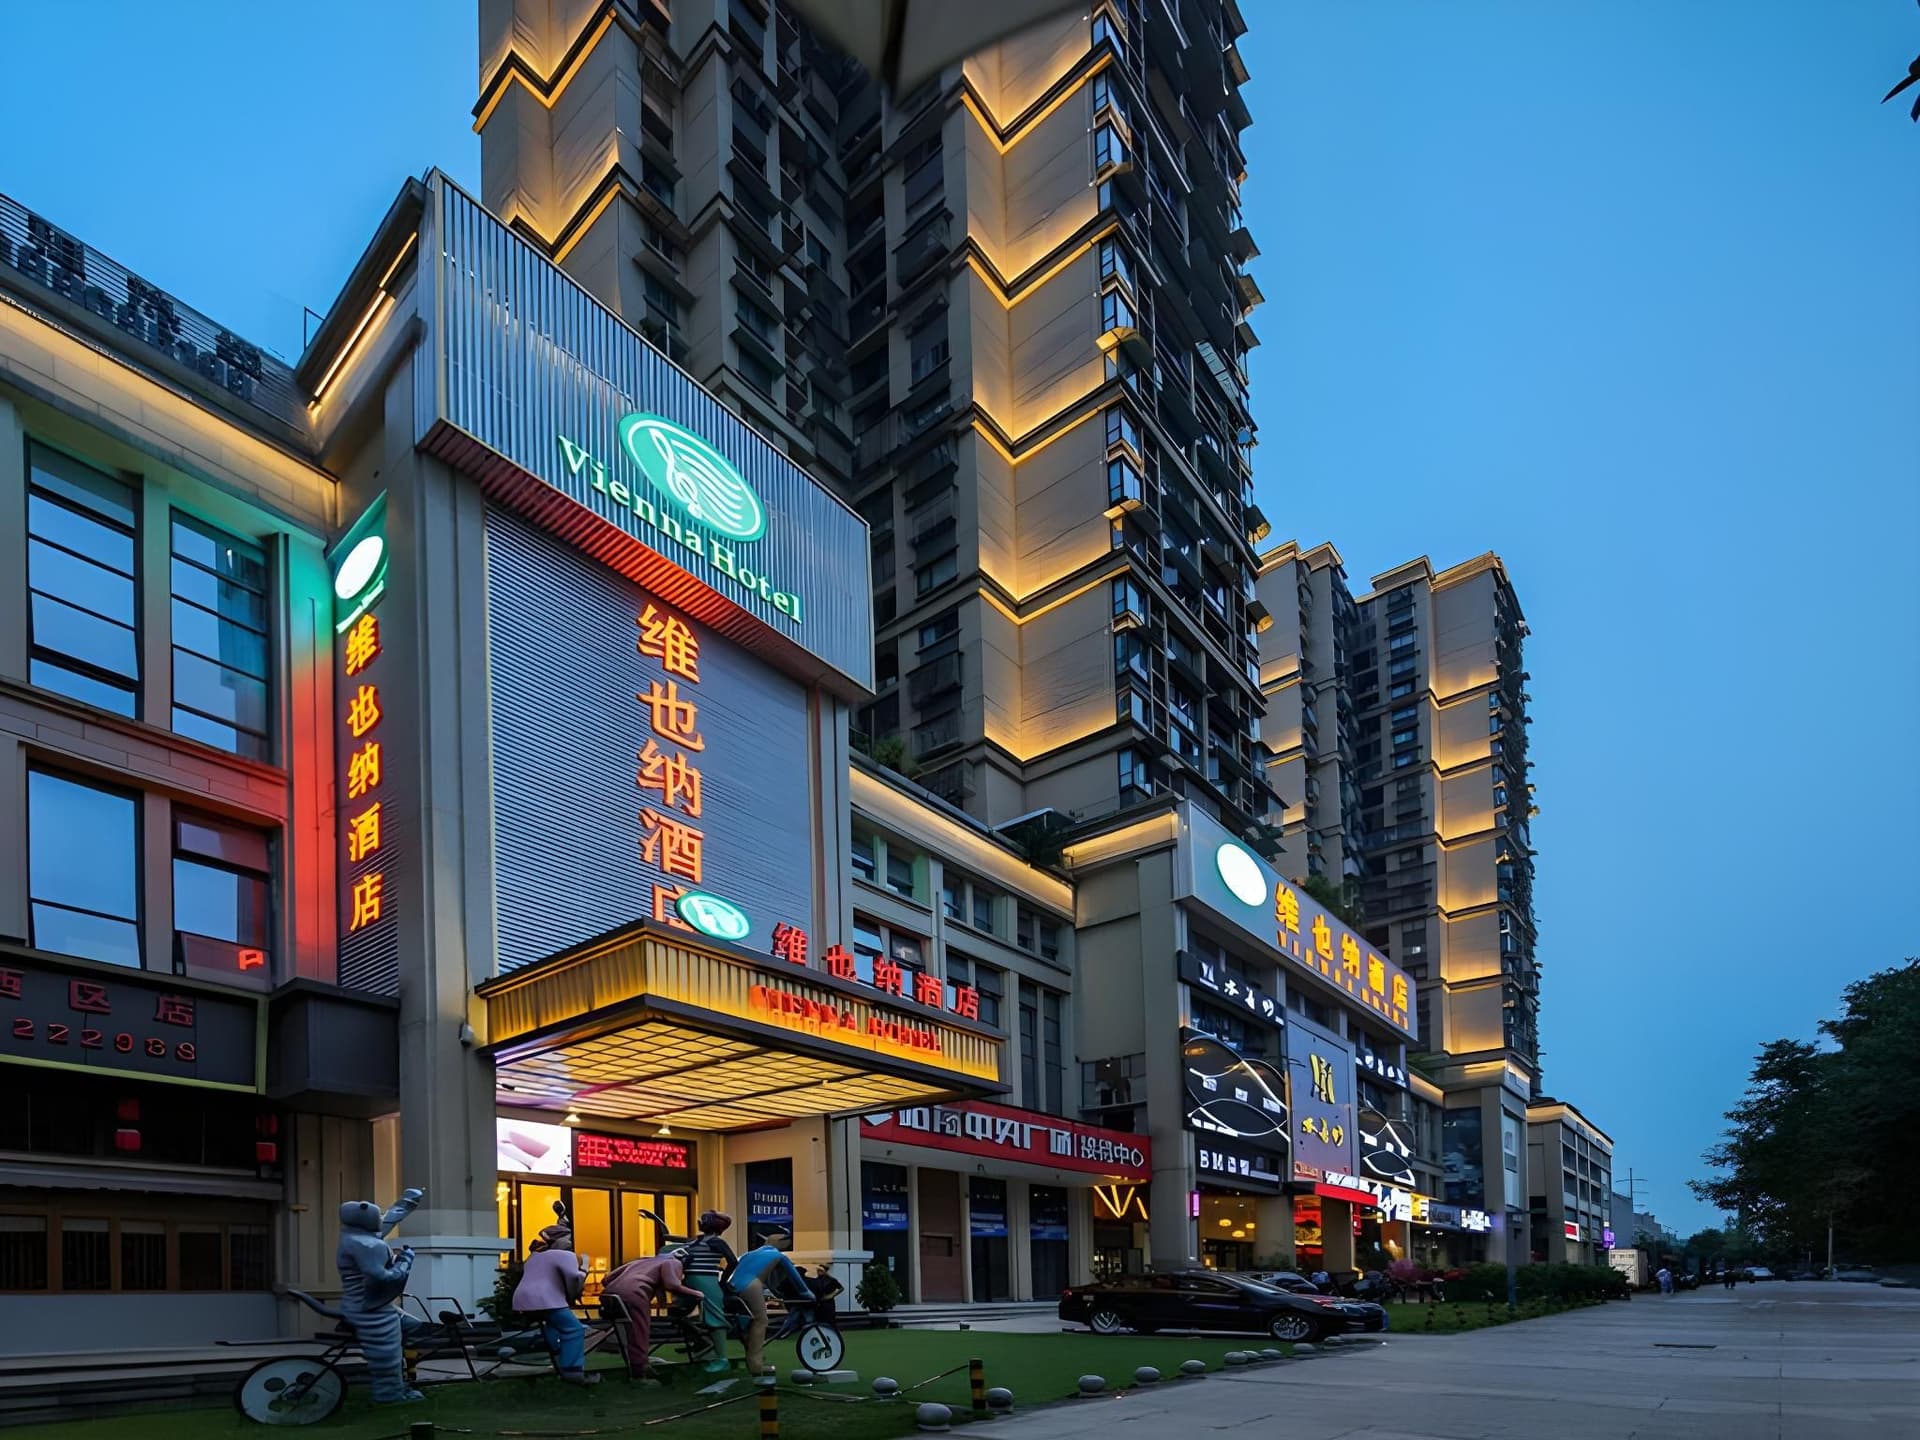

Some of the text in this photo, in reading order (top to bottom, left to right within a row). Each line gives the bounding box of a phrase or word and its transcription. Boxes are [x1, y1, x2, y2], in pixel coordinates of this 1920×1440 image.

[558, 434, 802, 624] Vienna Hotel
[344, 613, 384, 932] 维也纳酒店
[771, 921, 979, 1022] 维也纳酒店
